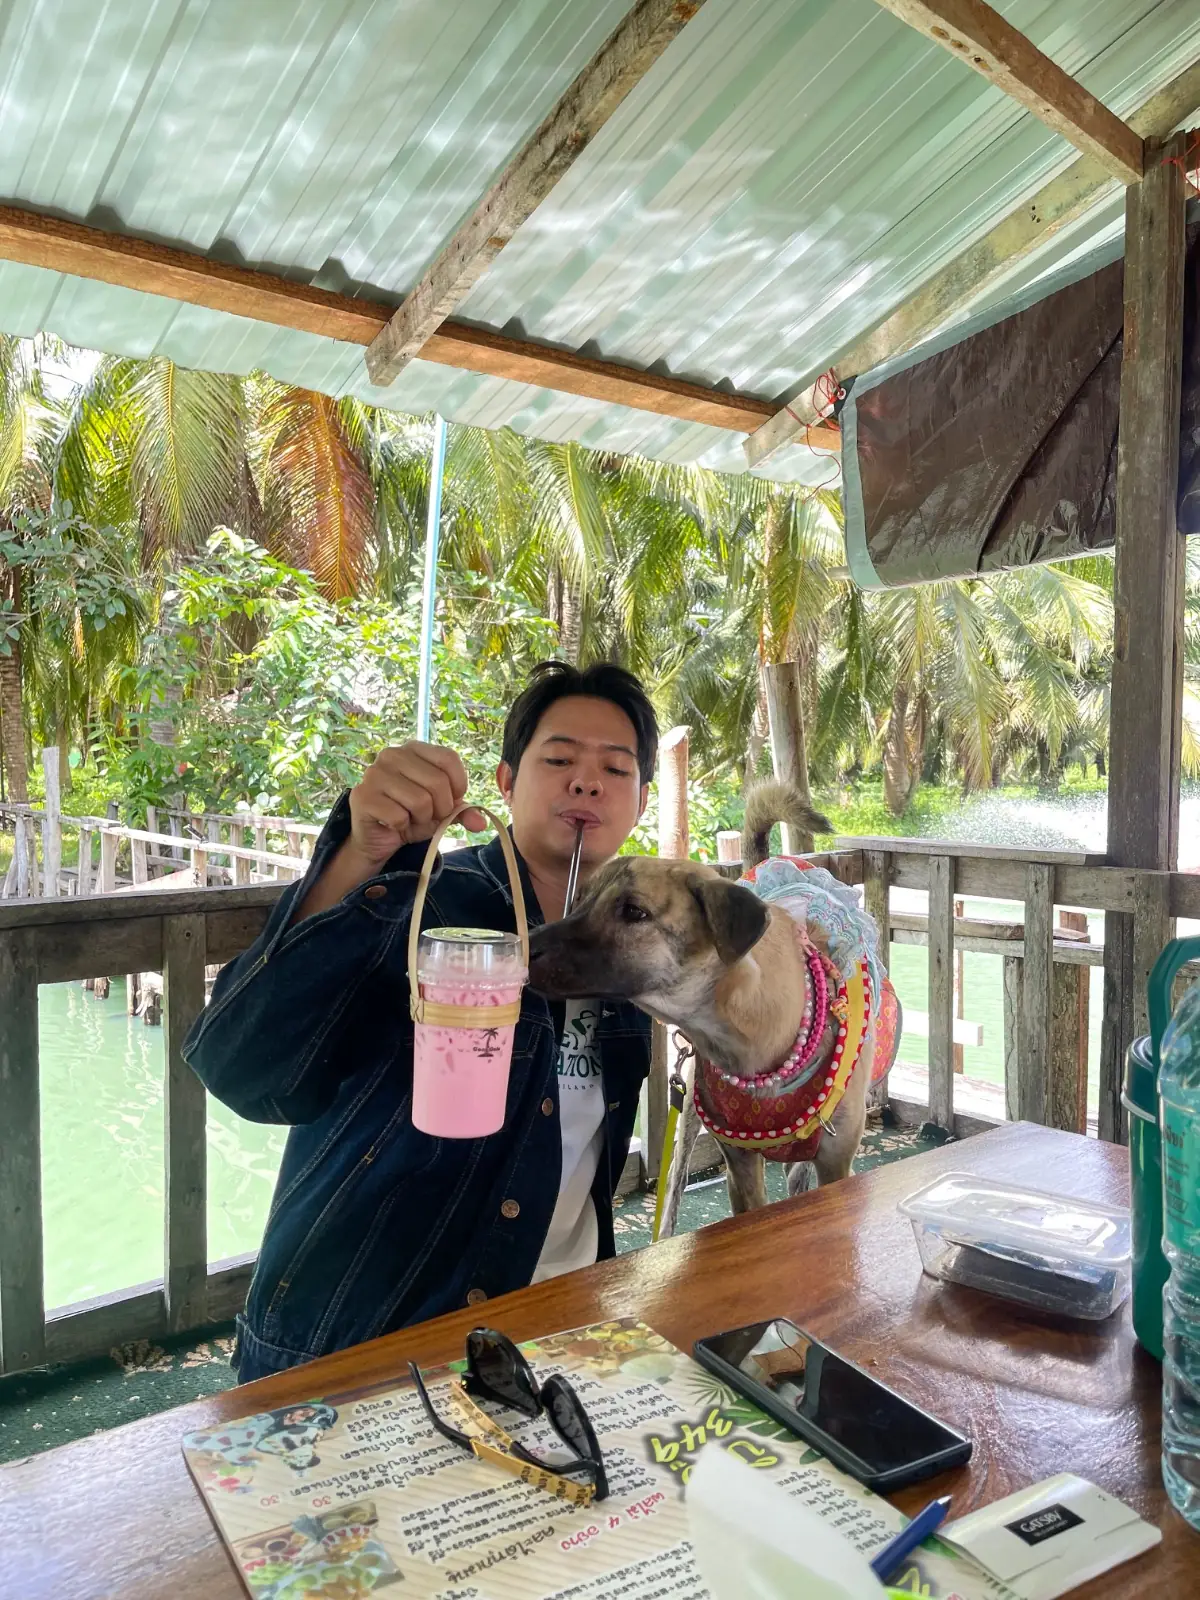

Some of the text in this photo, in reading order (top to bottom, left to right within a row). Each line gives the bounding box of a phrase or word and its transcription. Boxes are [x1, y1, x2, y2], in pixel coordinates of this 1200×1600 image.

[650, 1407, 732, 1463] 349
[259, 1495, 279, 1506] 30
[311, 1494, 332, 1508] 30
[560, 1492, 665, 1550] ผลไม้ 4 อย่าง
[1019, 1509, 1063, 1534] GATSBY
